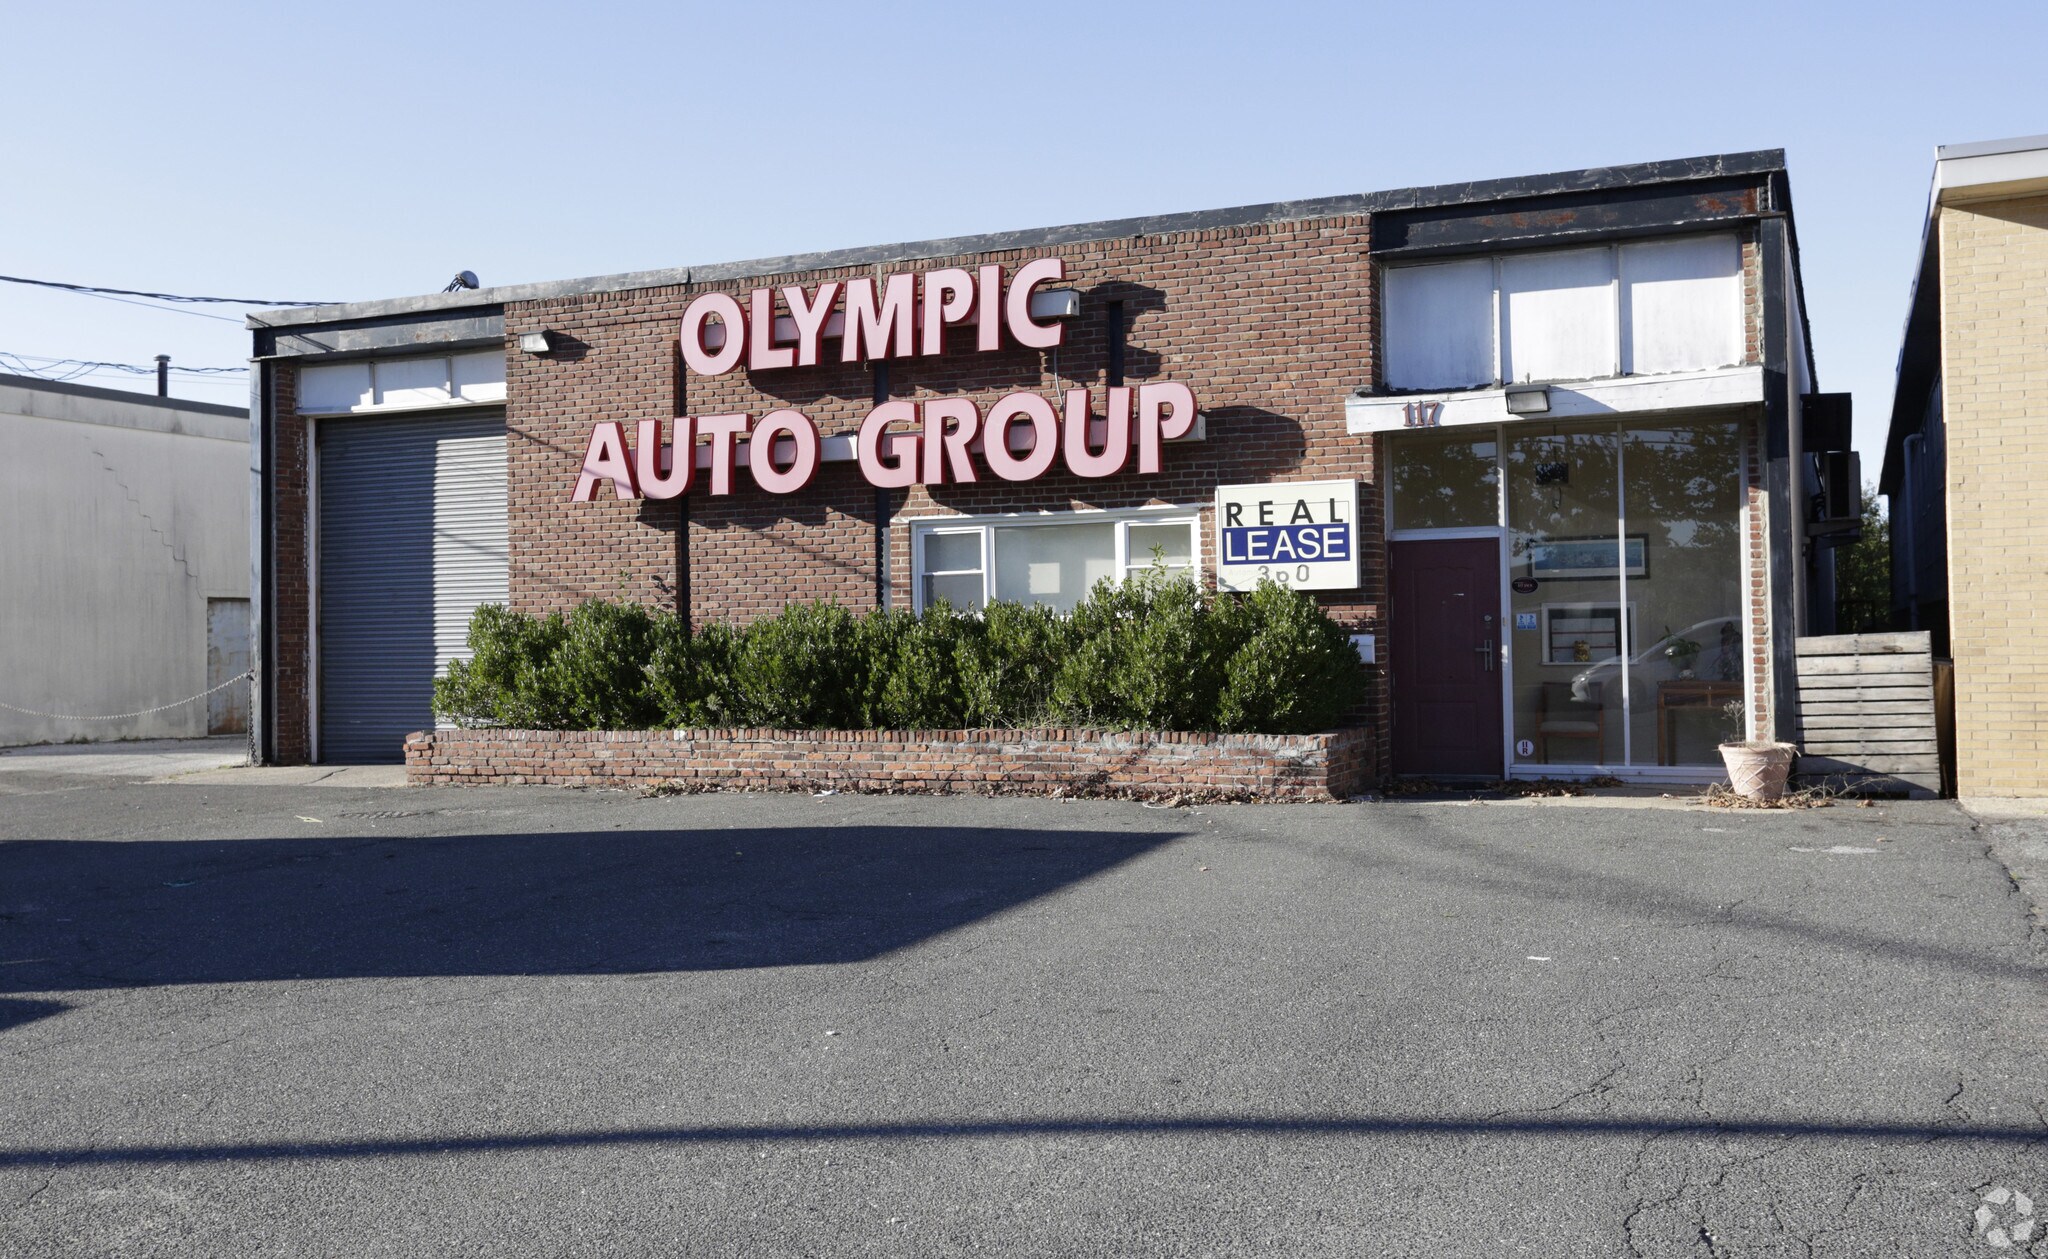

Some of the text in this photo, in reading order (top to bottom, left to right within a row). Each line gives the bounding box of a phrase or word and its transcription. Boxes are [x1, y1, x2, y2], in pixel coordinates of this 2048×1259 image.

[679, 257, 1067, 376] OLYMPIC
[1402, 400, 1440, 427] 117
[570, 381, 1199, 502] AUTO GROUP
[1226, 498, 1343, 527] REAL
[1226, 527, 1346, 562] LEASE
